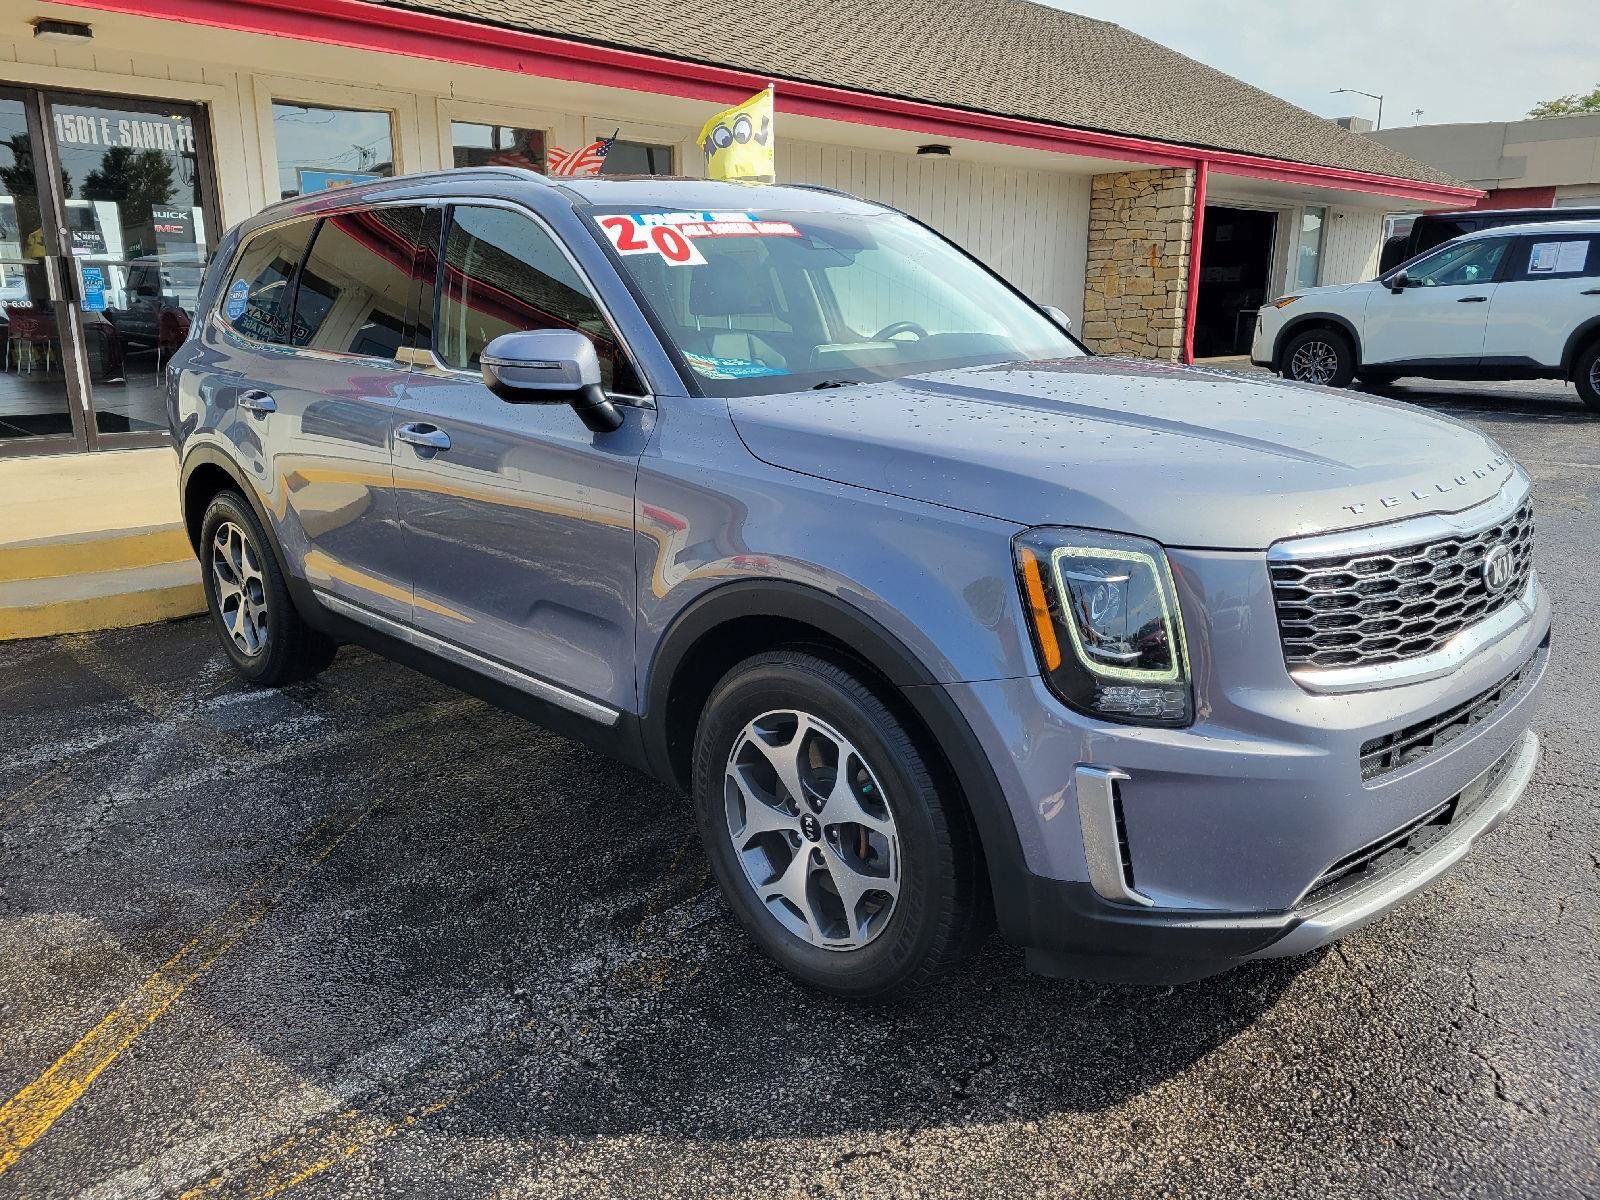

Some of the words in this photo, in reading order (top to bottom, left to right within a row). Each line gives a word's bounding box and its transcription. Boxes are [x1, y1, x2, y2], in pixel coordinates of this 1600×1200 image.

[54, 114, 98, 145] 1501
[100, 117, 118, 146] E.
[119, 120, 176, 151] SANTA
[176, 124, 196, 153] FE
[601, 217, 691, 262] 20
[804, 816, 814, 840] KIA
